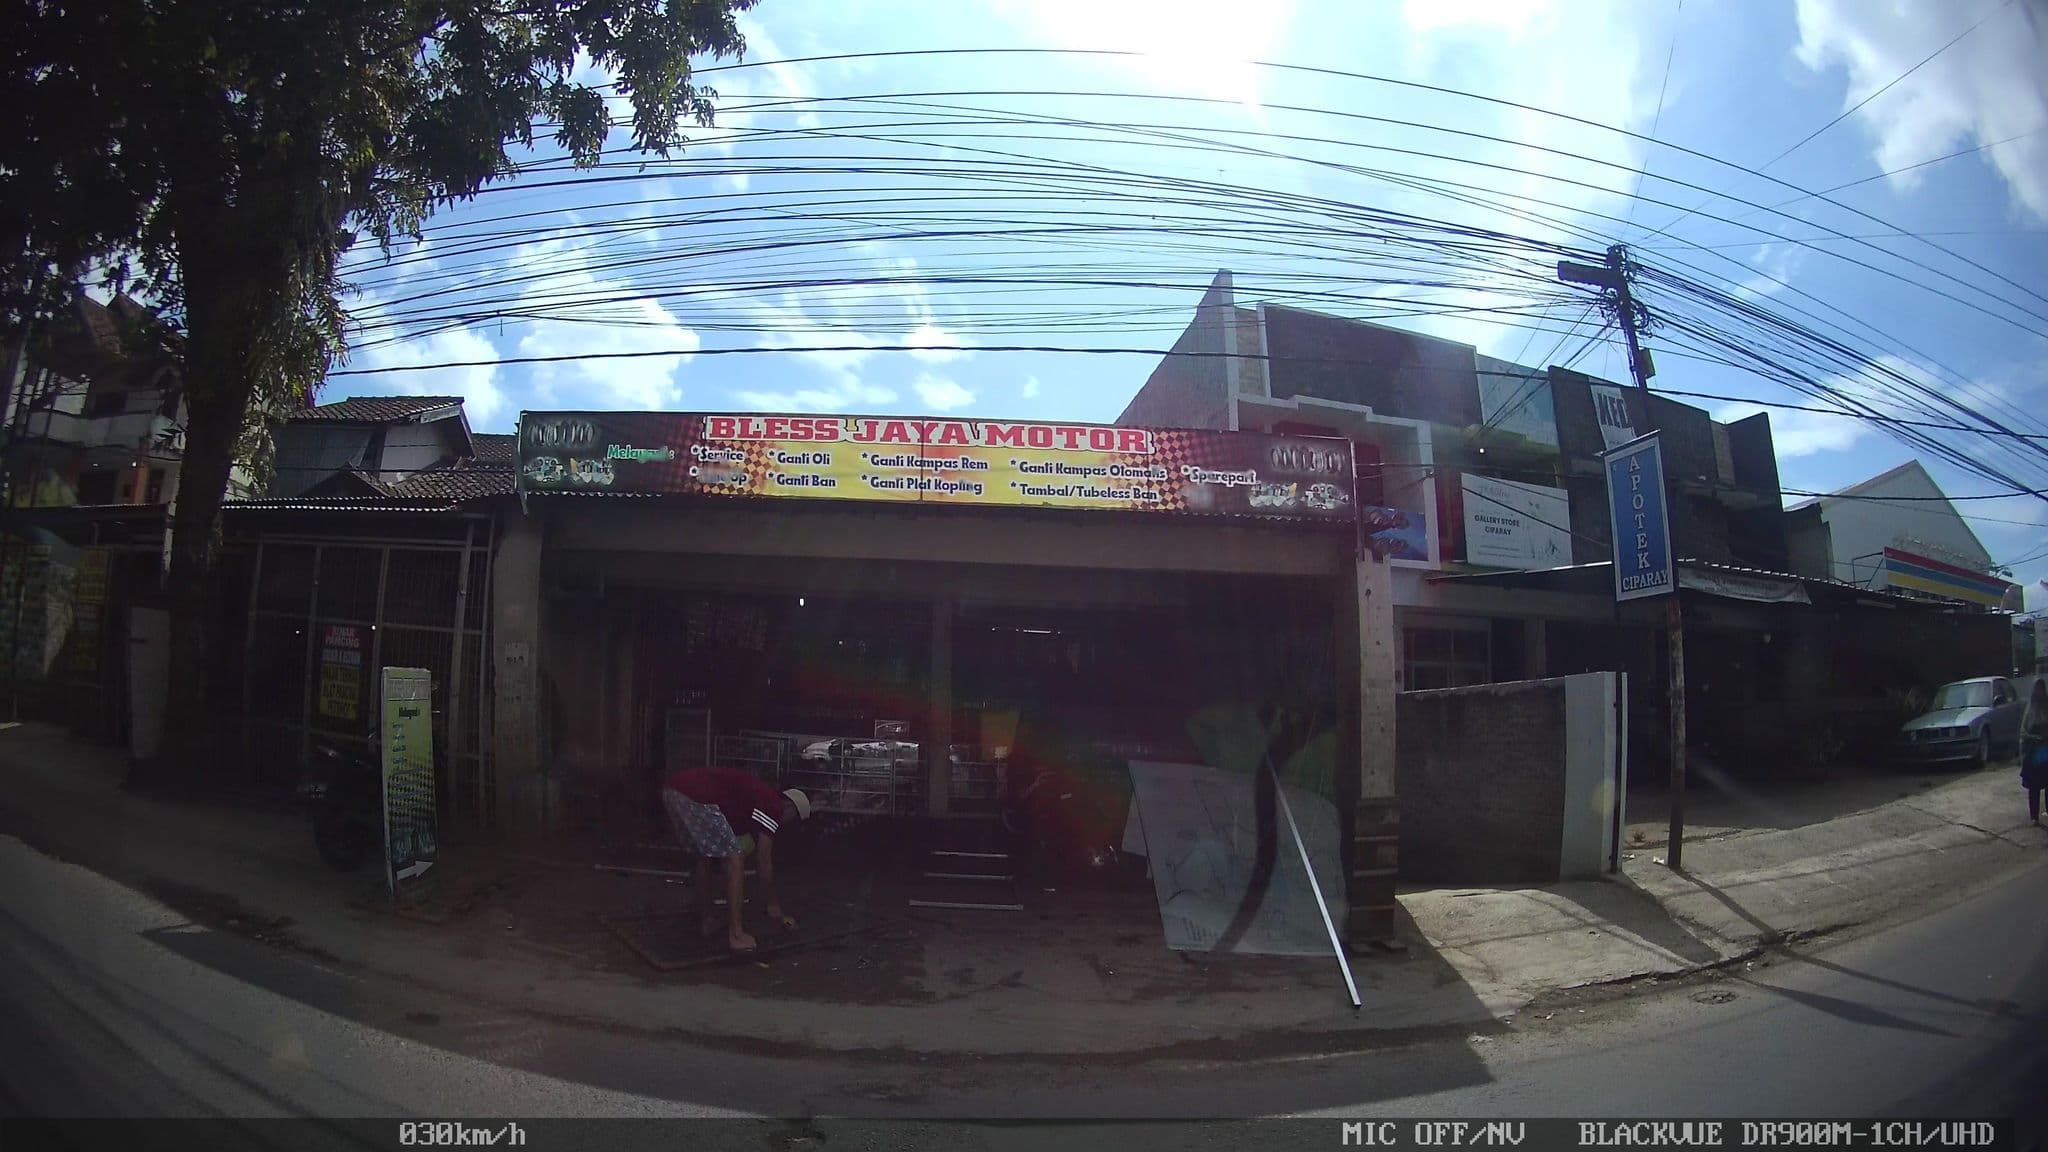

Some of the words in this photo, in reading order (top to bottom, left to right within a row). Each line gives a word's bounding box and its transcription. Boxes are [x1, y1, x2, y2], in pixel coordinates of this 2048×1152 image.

[709, 417, 840, 441] BLESS
[853, 420, 970, 445] JAYA
[984, 423, 1147, 453] MOTOR
[699, 447, 744, 461] Service
[777, 452, 810, 465] Ganti
[812, 452, 830, 465] Oli
[870, 454, 904, 467] Ganti
[906, 455, 958, 471] Kampas
[961, 457, 988, 470] Rem
[1019, 461, 1053, 474] Ganti
[1055, 462, 1107, 479] Kampas
[776, 473, 809, 486] Ganti
[812, 474, 836, 487] Ban
[870, 476, 904, 489] Ganti
[906, 477, 931, 490] Plat
[934, 478, 983, 495] Kopling
[1133, 486, 1158, 500] Ban
[1628, 455, 1650, 570] APOTEK
[1622, 569, 1669, 592] CIPARAY
